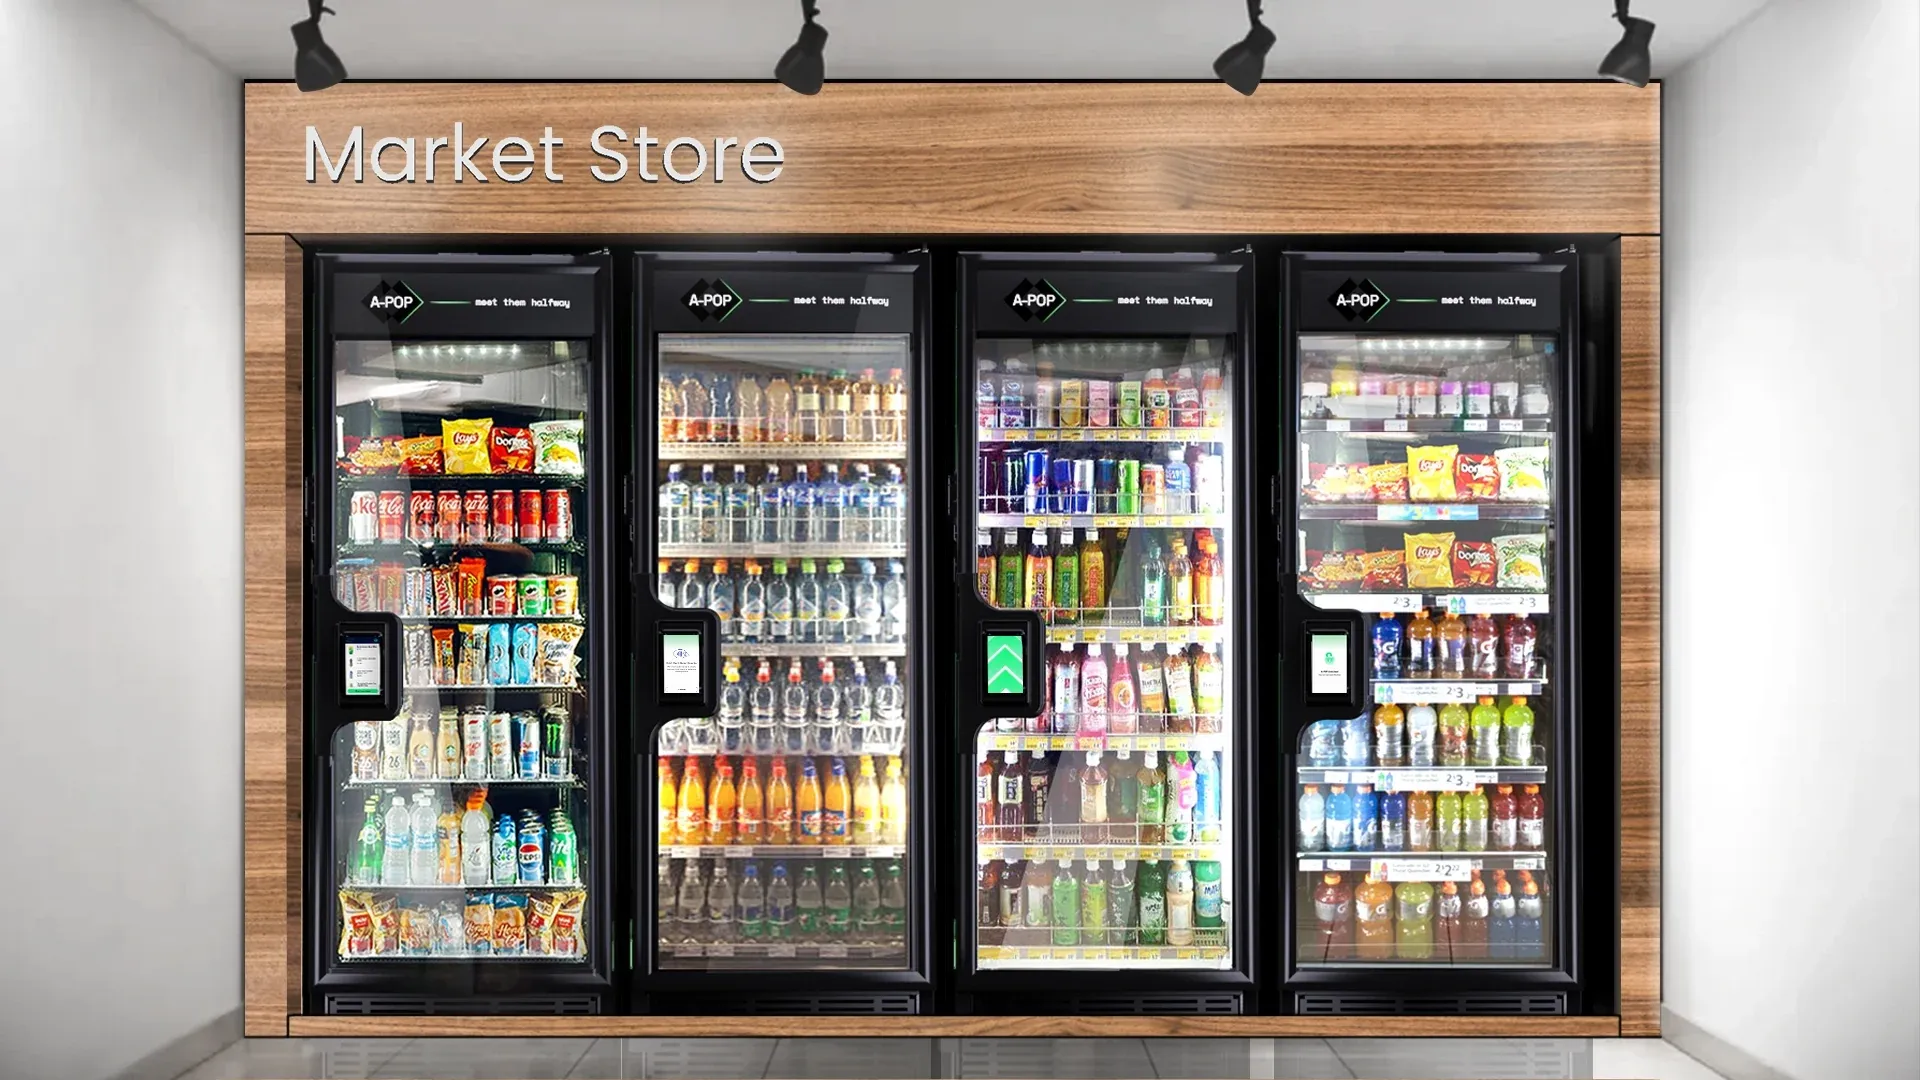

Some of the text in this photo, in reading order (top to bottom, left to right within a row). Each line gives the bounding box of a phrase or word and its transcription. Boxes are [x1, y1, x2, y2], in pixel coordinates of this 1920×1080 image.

[304, 121, 786, 183] Market Store
[370, 296, 414, 309] A-POP
[474, 297, 571, 310] meet them halfway
[689, 294, 733, 307] A-POP
[793, 295, 890, 308] meet them halfway
[1013, 294, 1057, 307] A-POP
[1117, 295, 1214, 308] meet them halfway
[1336, 294, 1380, 307] A-POP
[1440, 295, 1537, 308] meet them halfway
[1382, 642, 1395, 654] G
[1480, 640, 1493, 654] G
[388, 756, 401, 769] 26
[1376, 904, 1386, 914] G
[1416, 903, 1426, 914] G
